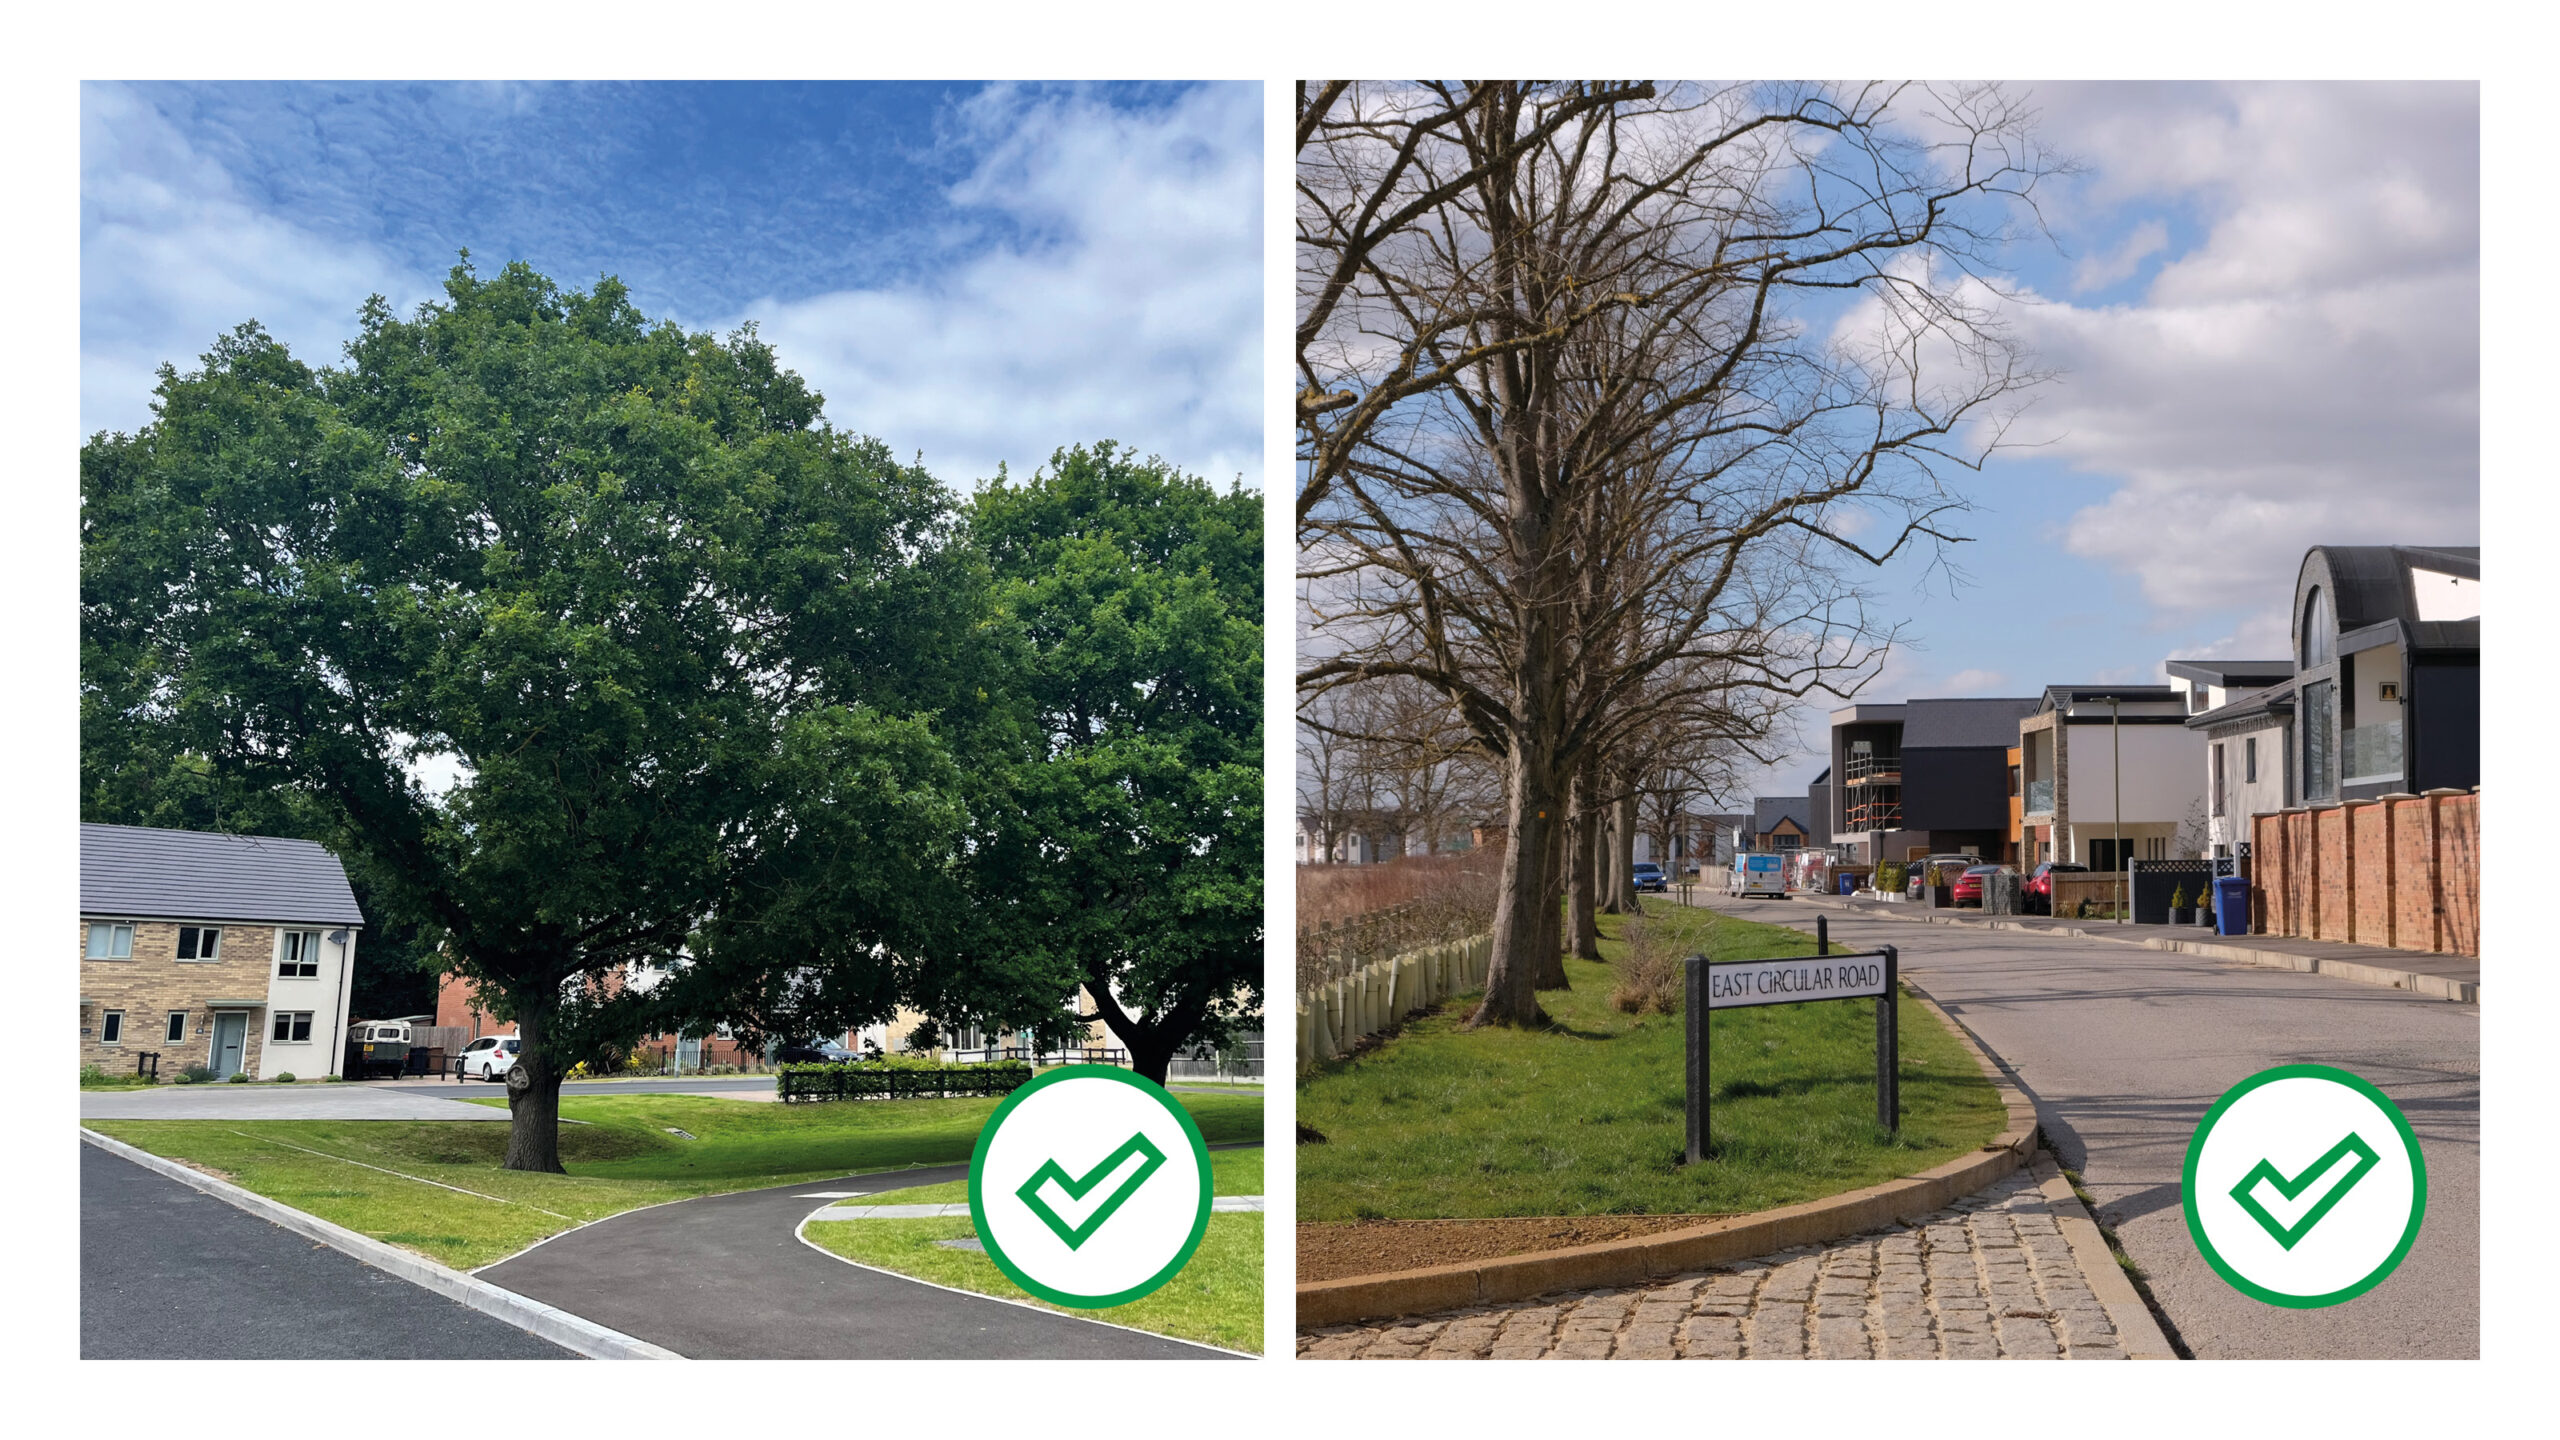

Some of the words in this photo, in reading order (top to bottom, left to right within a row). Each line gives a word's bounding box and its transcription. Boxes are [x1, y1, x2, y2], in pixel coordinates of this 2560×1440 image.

[1712, 972, 1753, 998] EAST
[1757, 968, 1834, 994] CIRCULAR
[1839, 964, 1880, 988] ROAD
